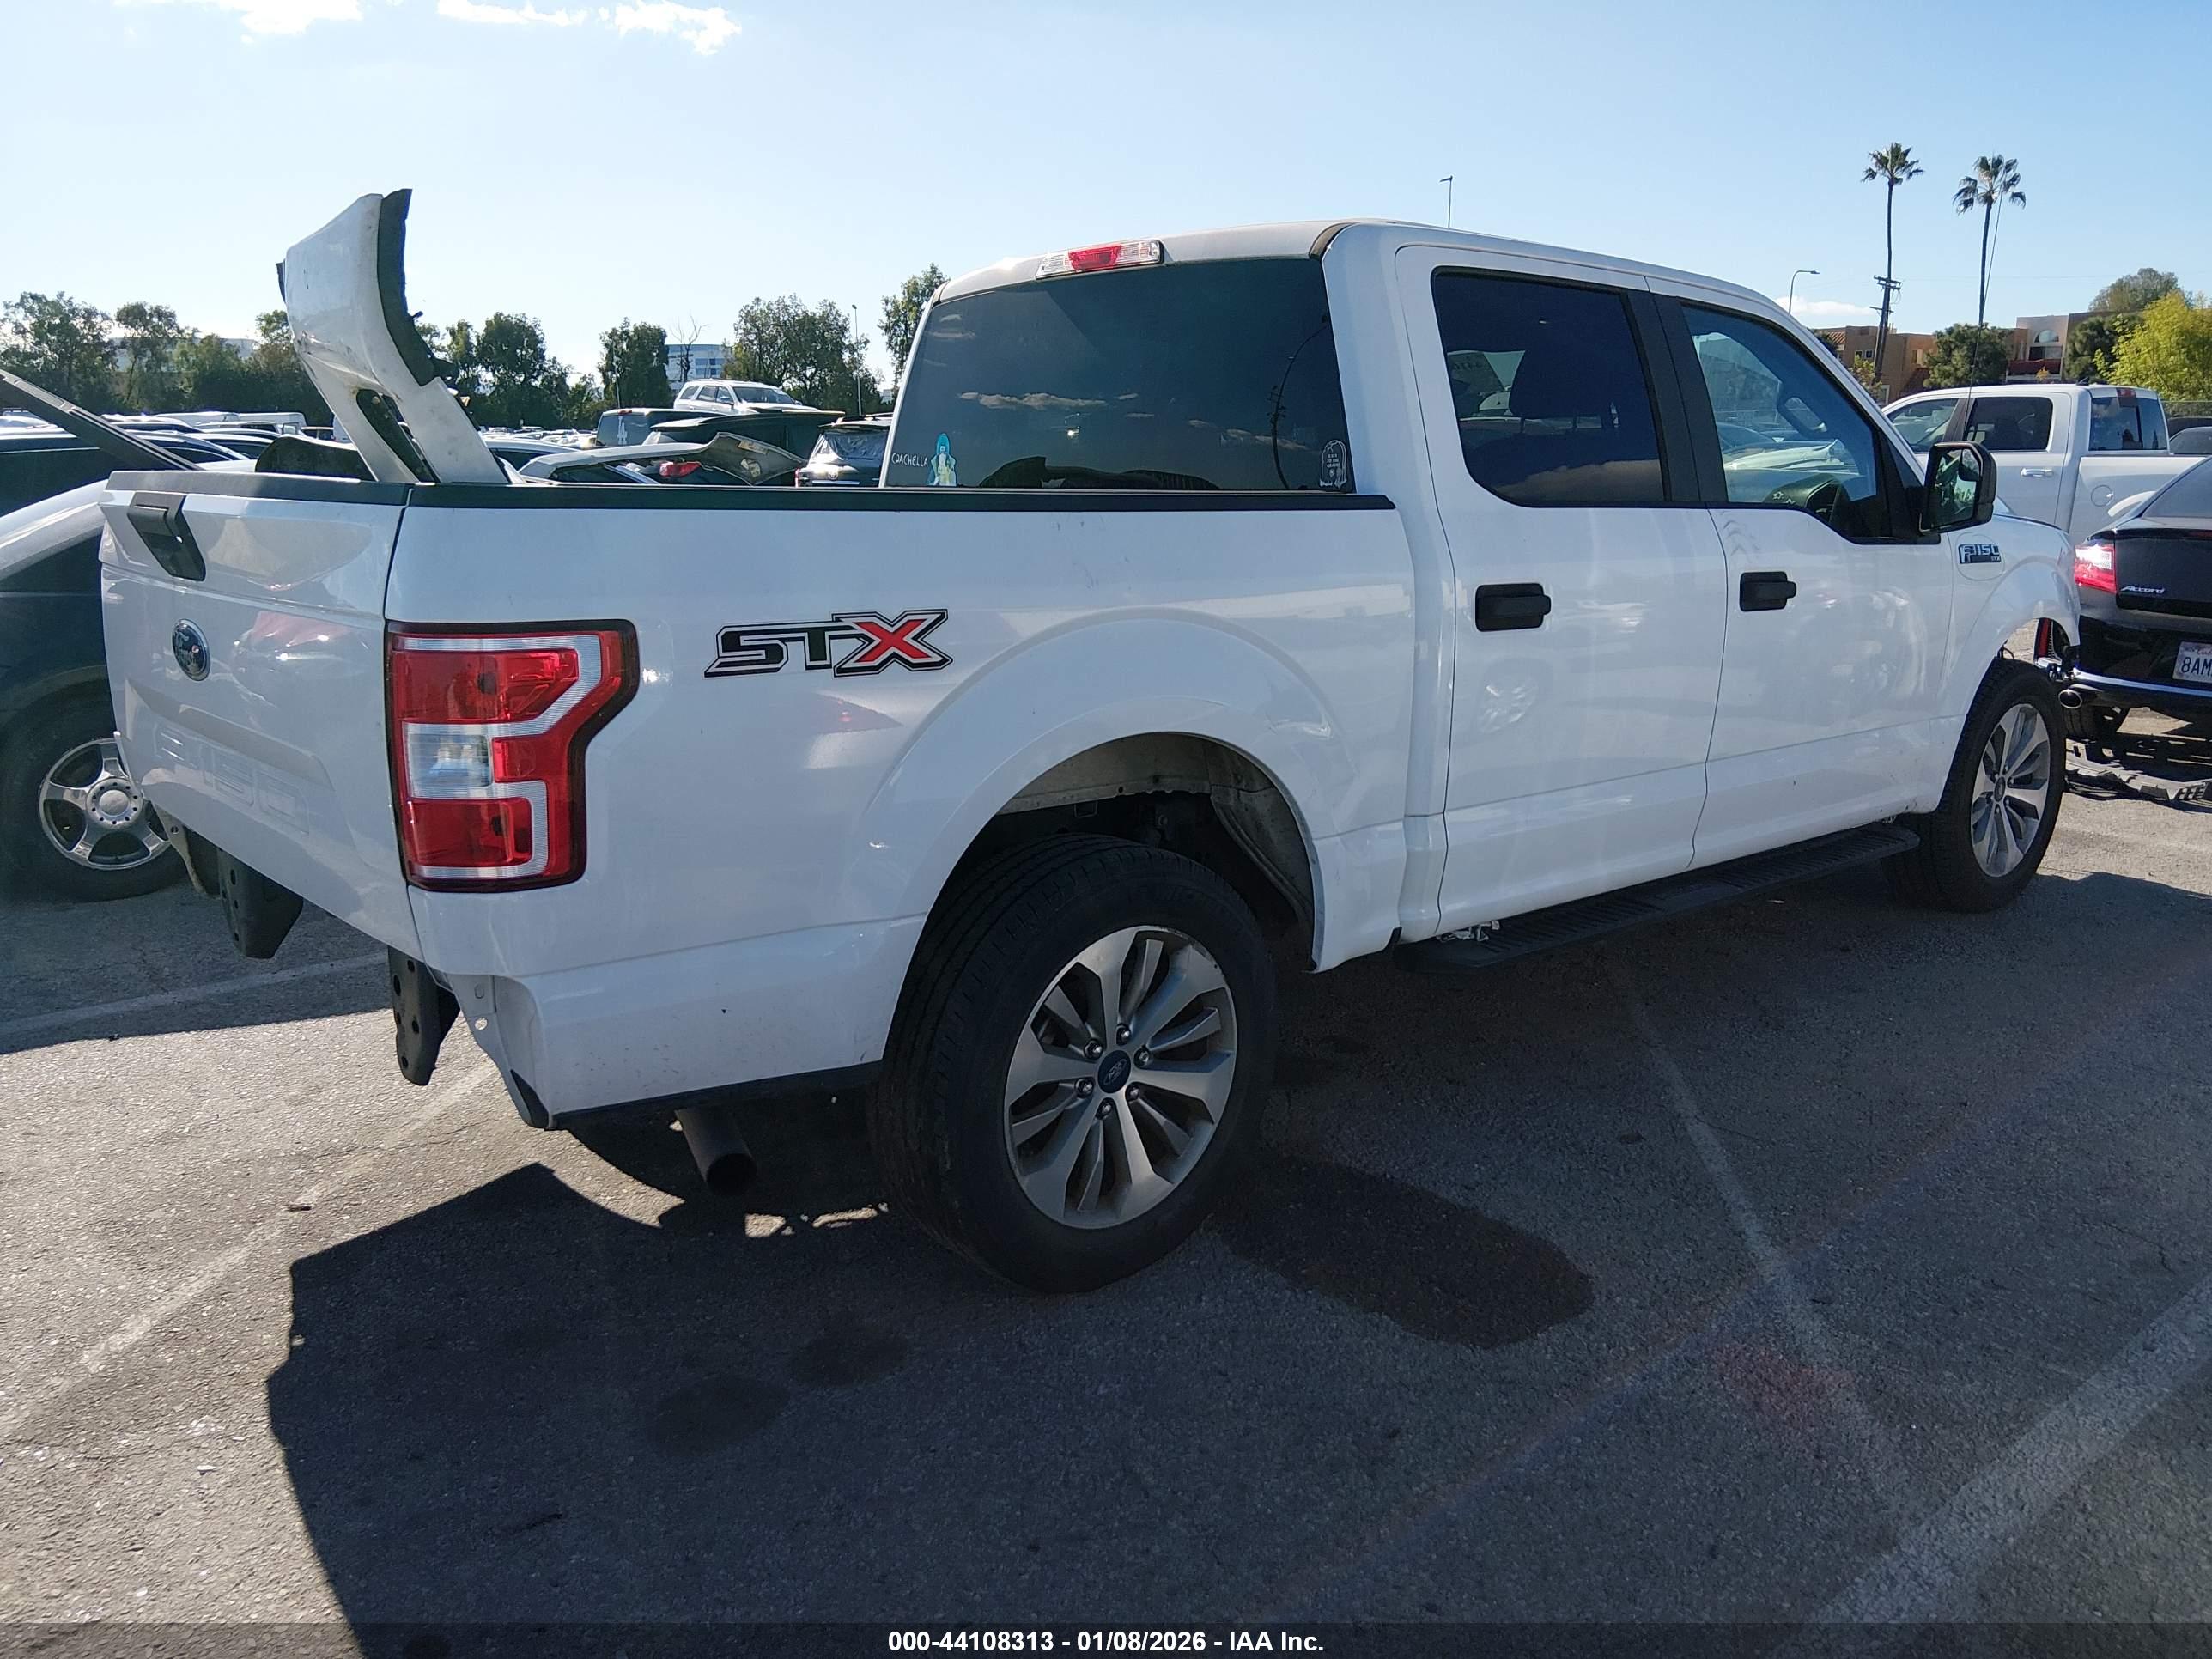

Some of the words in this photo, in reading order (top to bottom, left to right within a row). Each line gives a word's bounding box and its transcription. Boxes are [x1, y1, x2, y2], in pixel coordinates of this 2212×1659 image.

[891, 453, 928, 467] COACHELLA
[2120, 586, 2165, 594] Accord
[703, 609, 953, 678] STX
